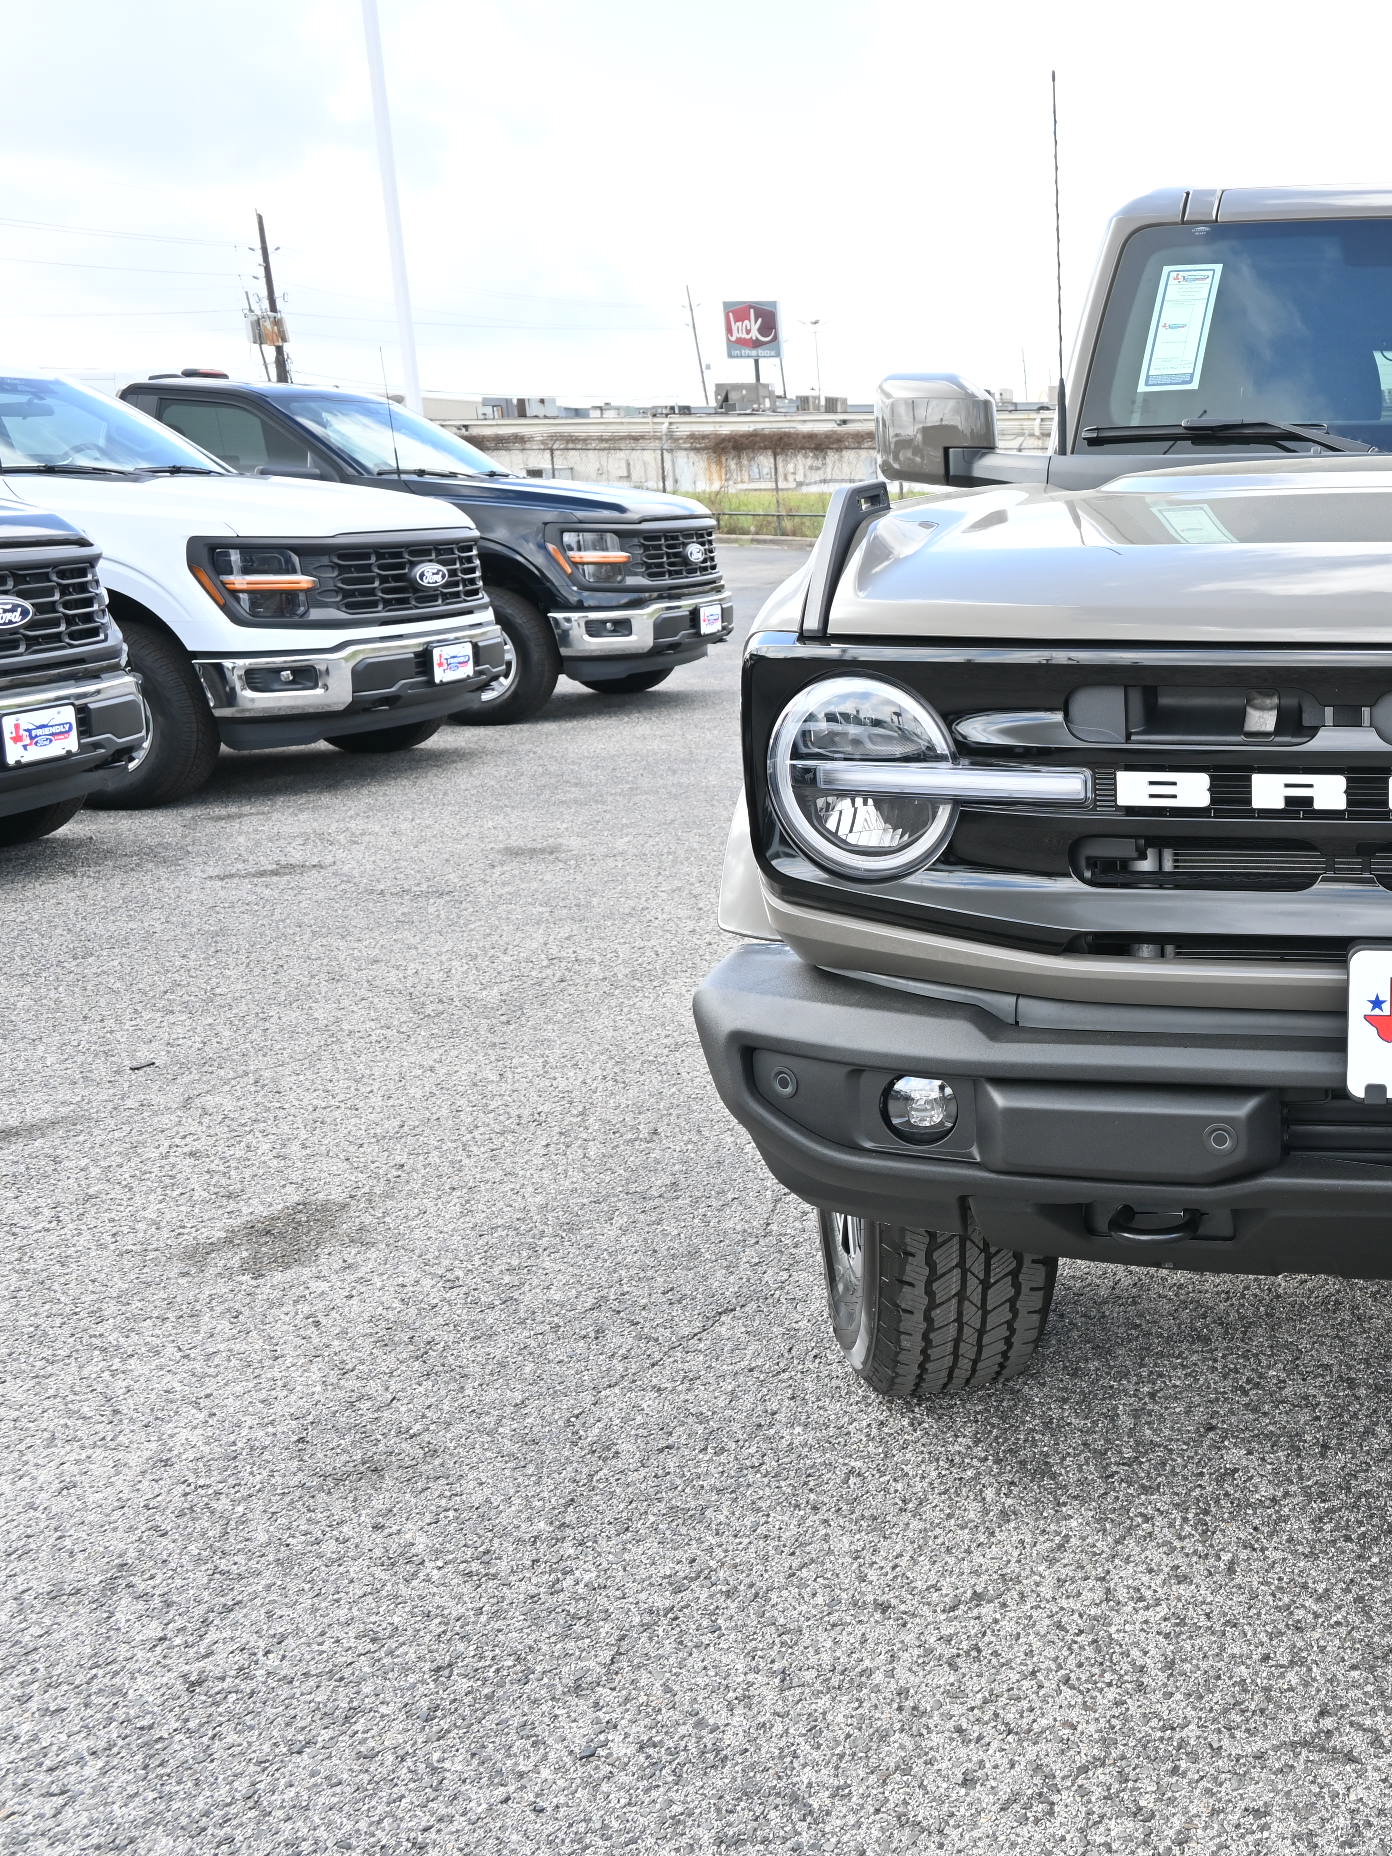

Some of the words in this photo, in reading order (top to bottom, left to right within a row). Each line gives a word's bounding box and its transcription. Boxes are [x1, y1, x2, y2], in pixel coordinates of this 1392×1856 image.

[728, 309, 775, 341] Jack
[423, 568, 443, 583] Ford
[32, 723, 70, 737] FRIENDLY
